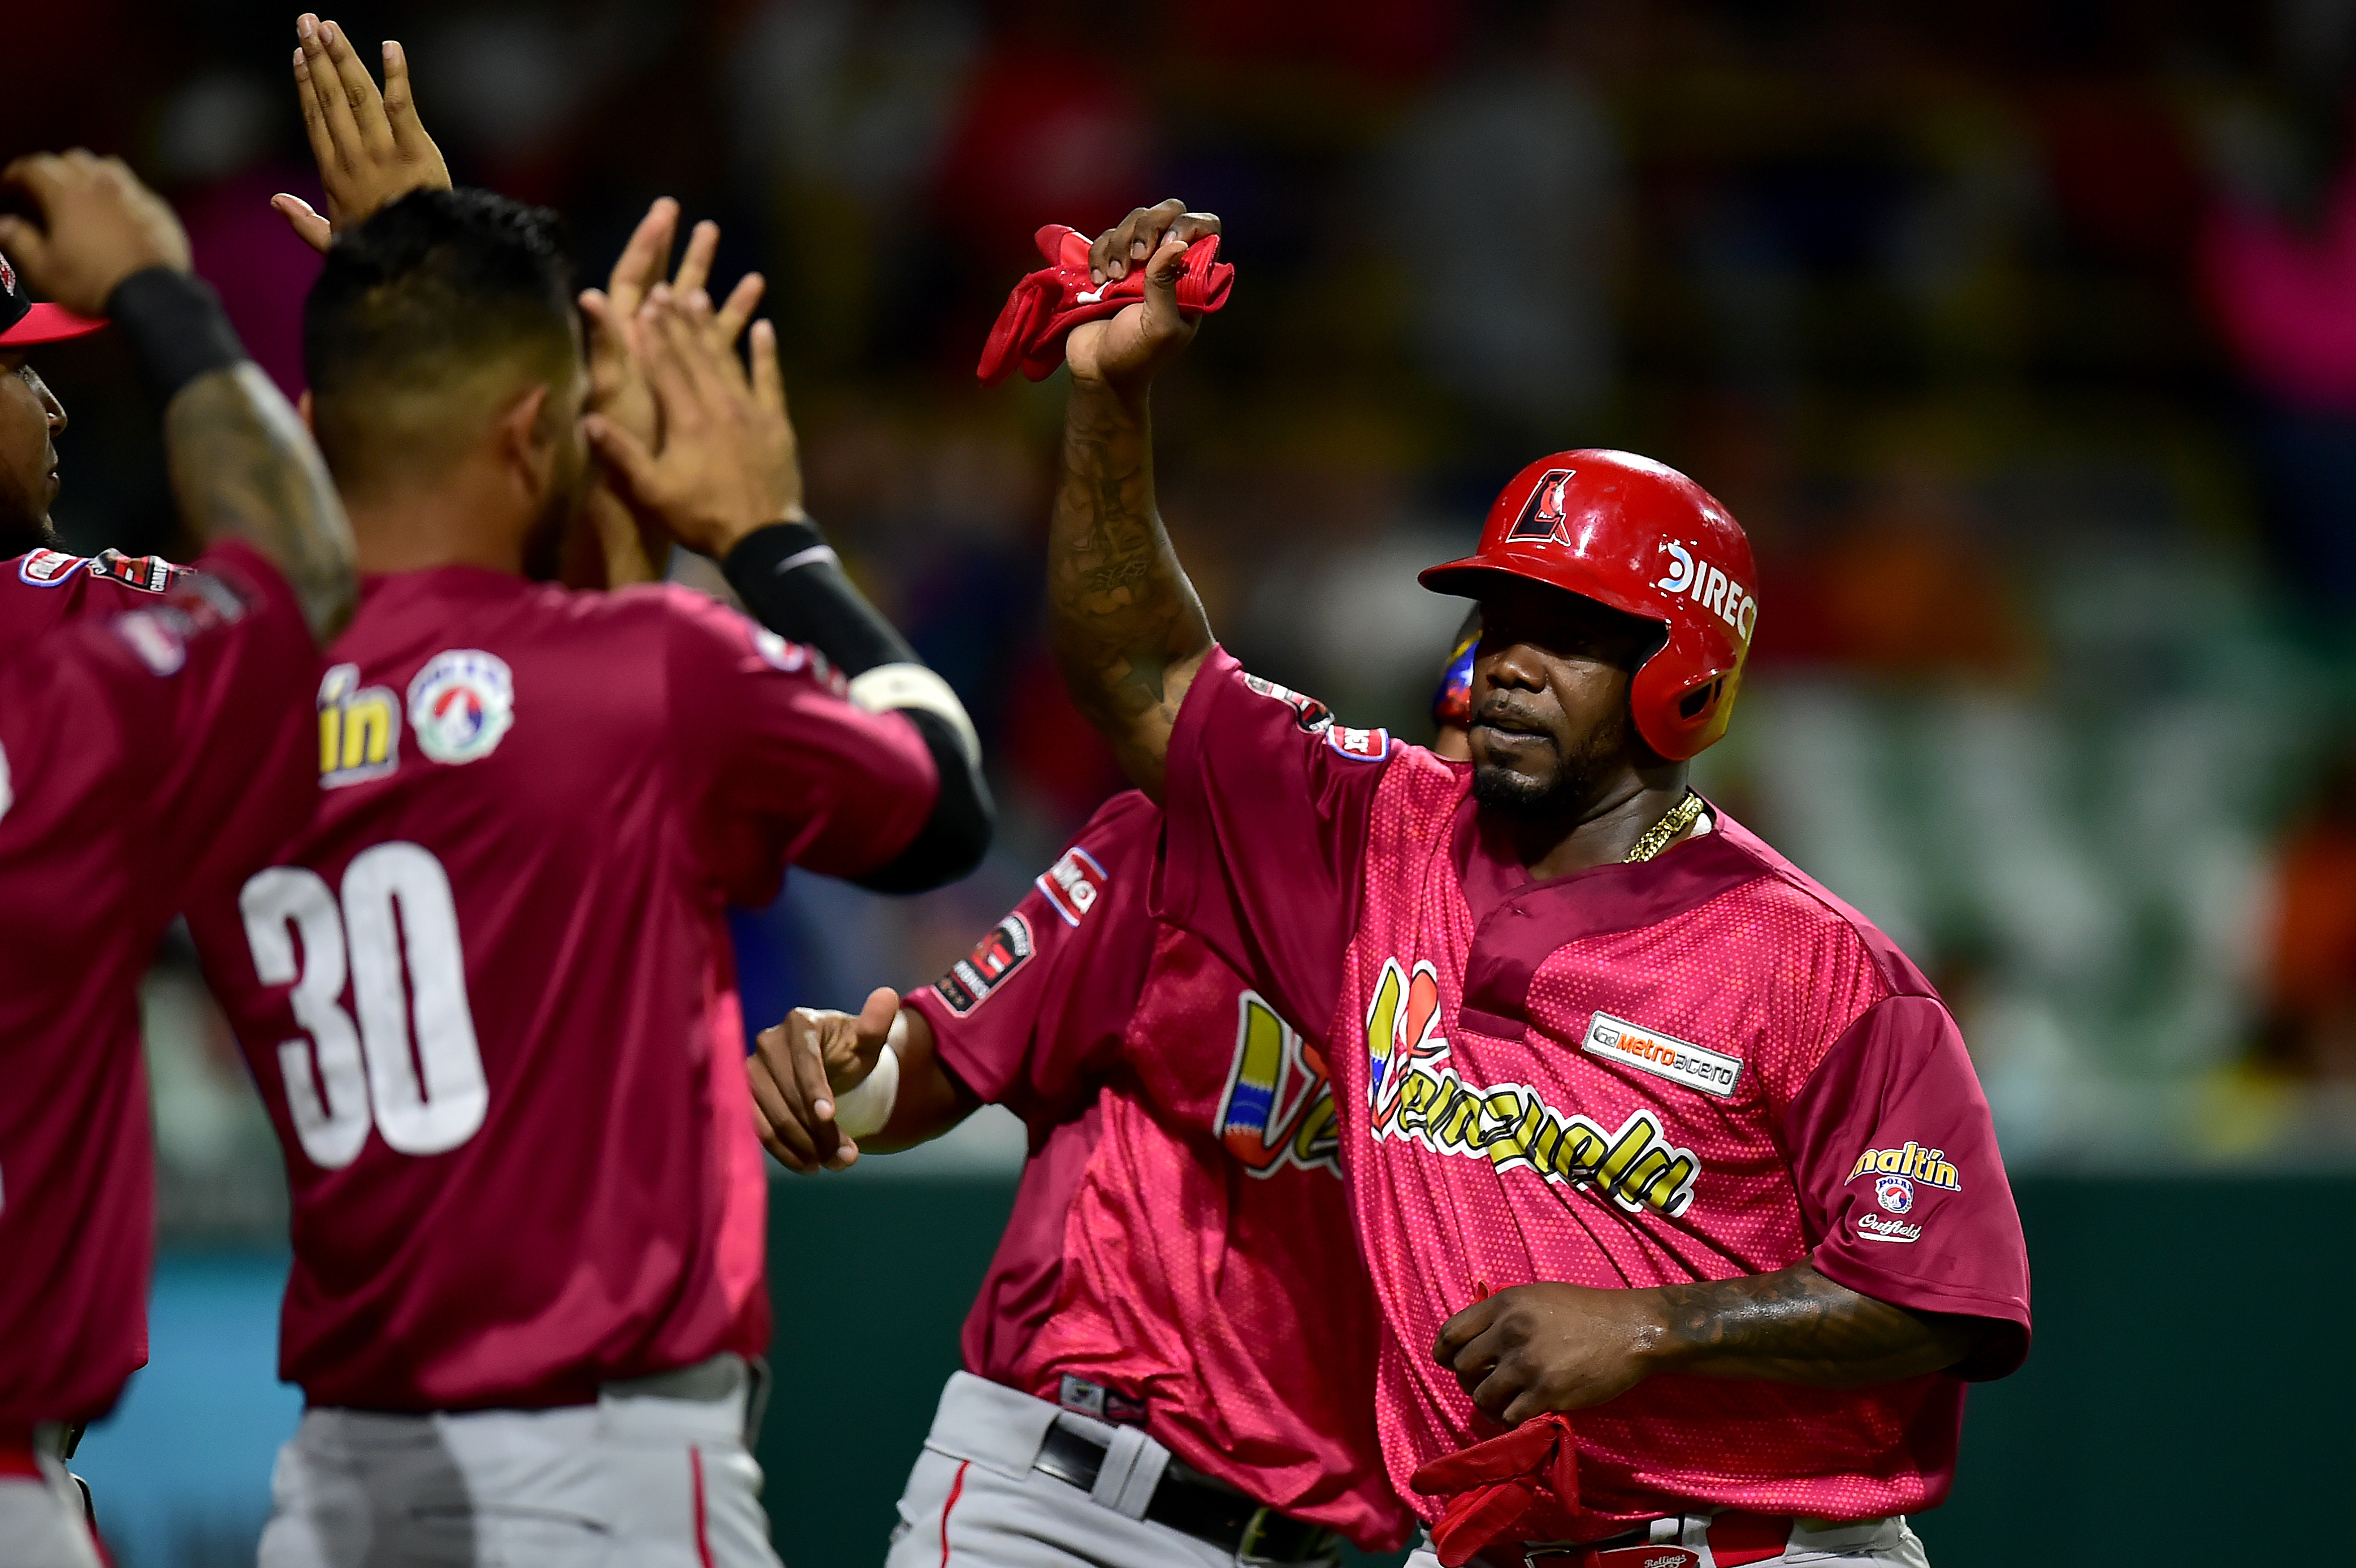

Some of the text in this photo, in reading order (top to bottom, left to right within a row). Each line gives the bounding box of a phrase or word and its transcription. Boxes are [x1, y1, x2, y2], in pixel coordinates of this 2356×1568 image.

[238, 840, 490, 1170] 30
[1616, 1032, 1733, 1085] Metroacero
[1858, 1212, 1922, 1239] Outfield
